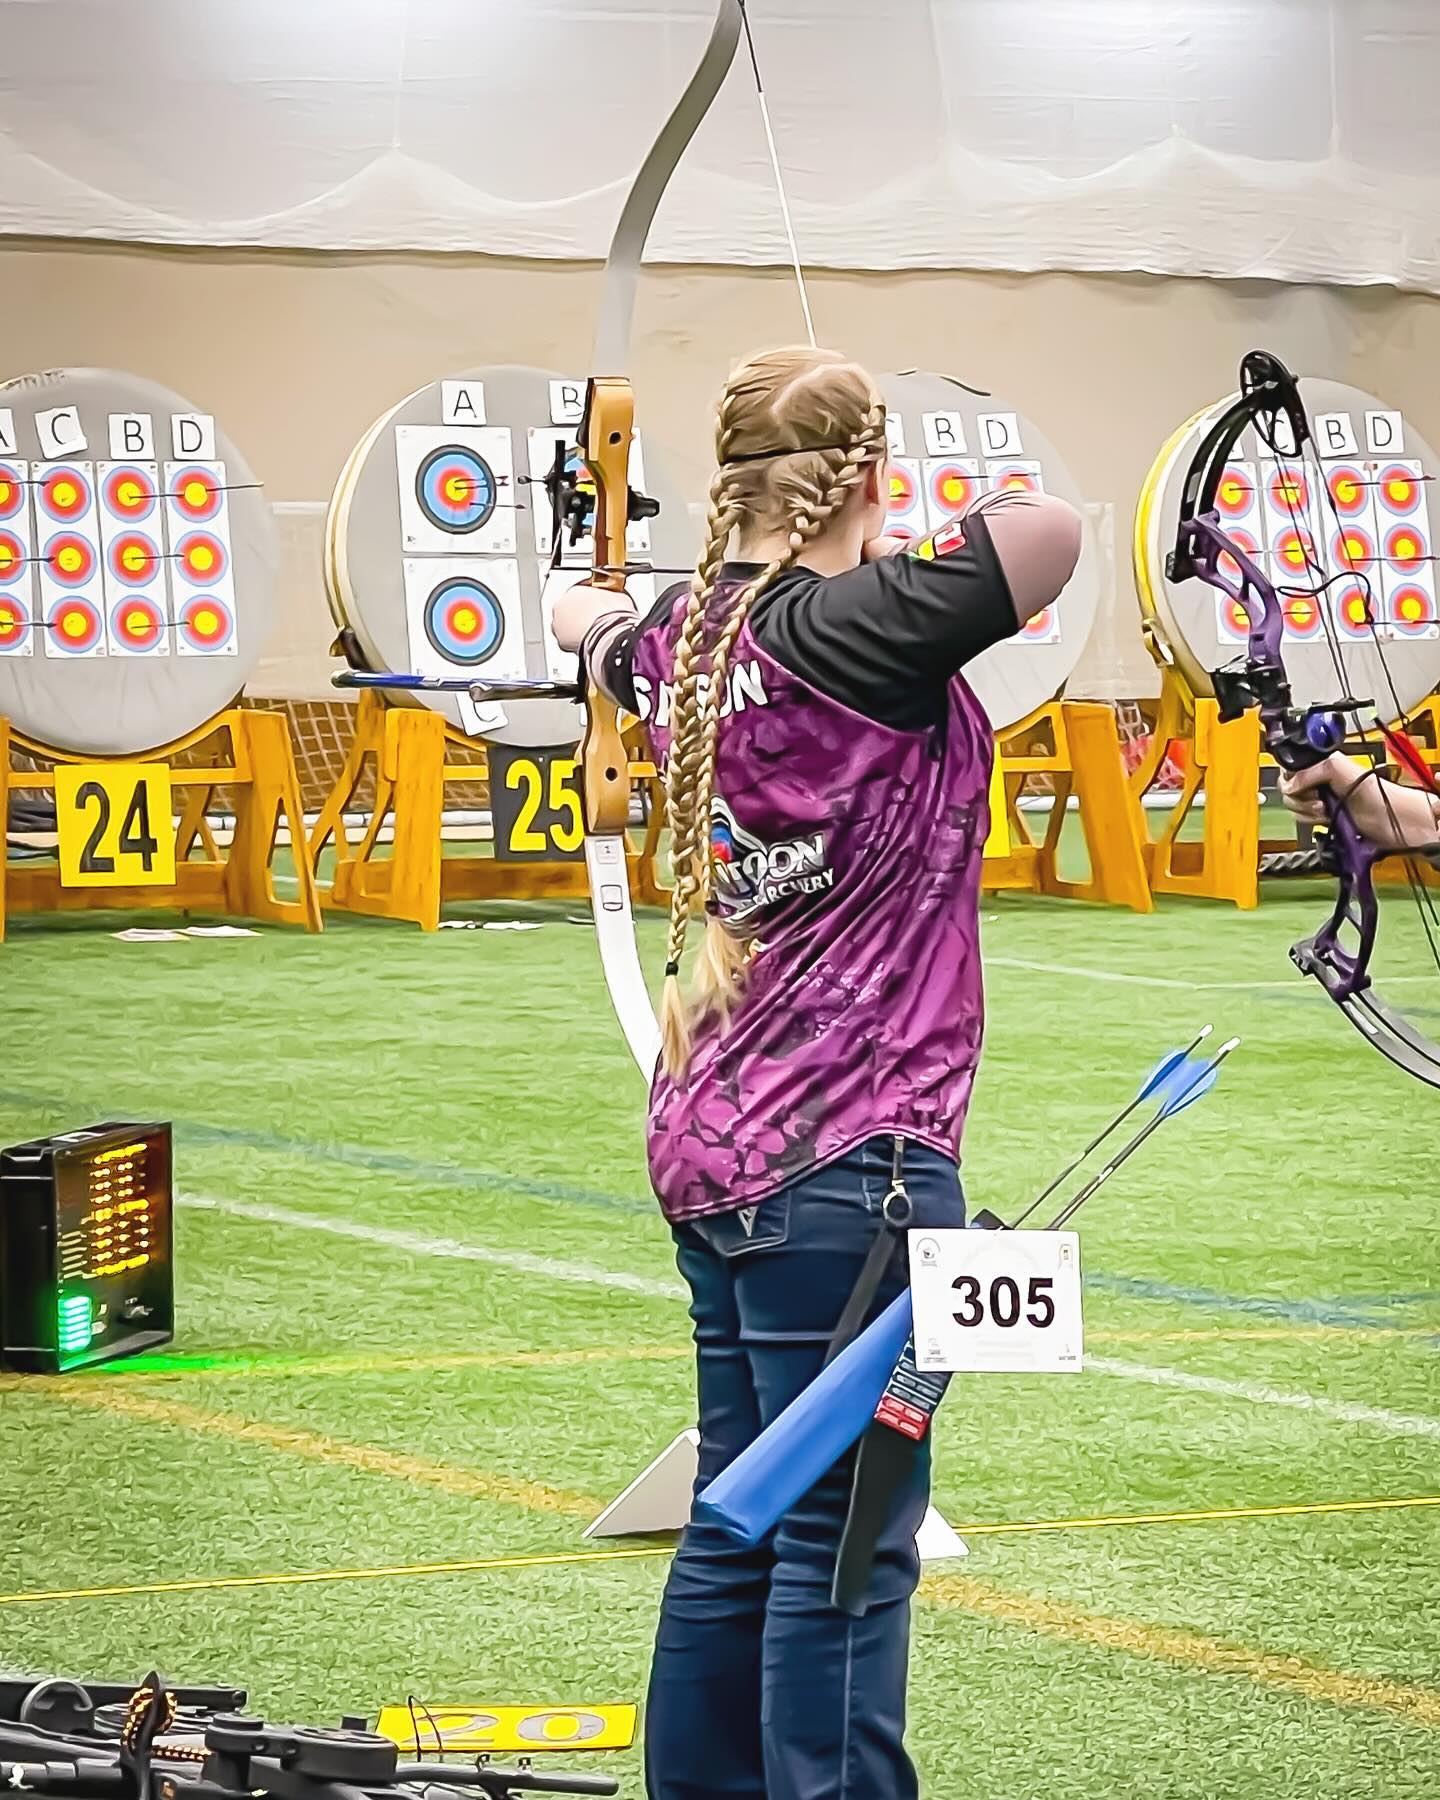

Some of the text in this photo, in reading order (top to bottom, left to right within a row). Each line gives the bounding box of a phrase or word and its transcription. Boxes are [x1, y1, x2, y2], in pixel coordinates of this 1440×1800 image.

[454, 386, 583, 418] A B
[52, 413, 203, 452] C B D
[934, 417, 956, 449] B
[986, 419, 1008, 450] D
[1325, 419, 1346, 449] B
[1372, 416, 1393, 447] D
[506, 759, 585, 852] 25
[75, 779, 159, 873] 24
[951, 1275, 1055, 1329] 305
[401, 1713, 605, 1743] 20
